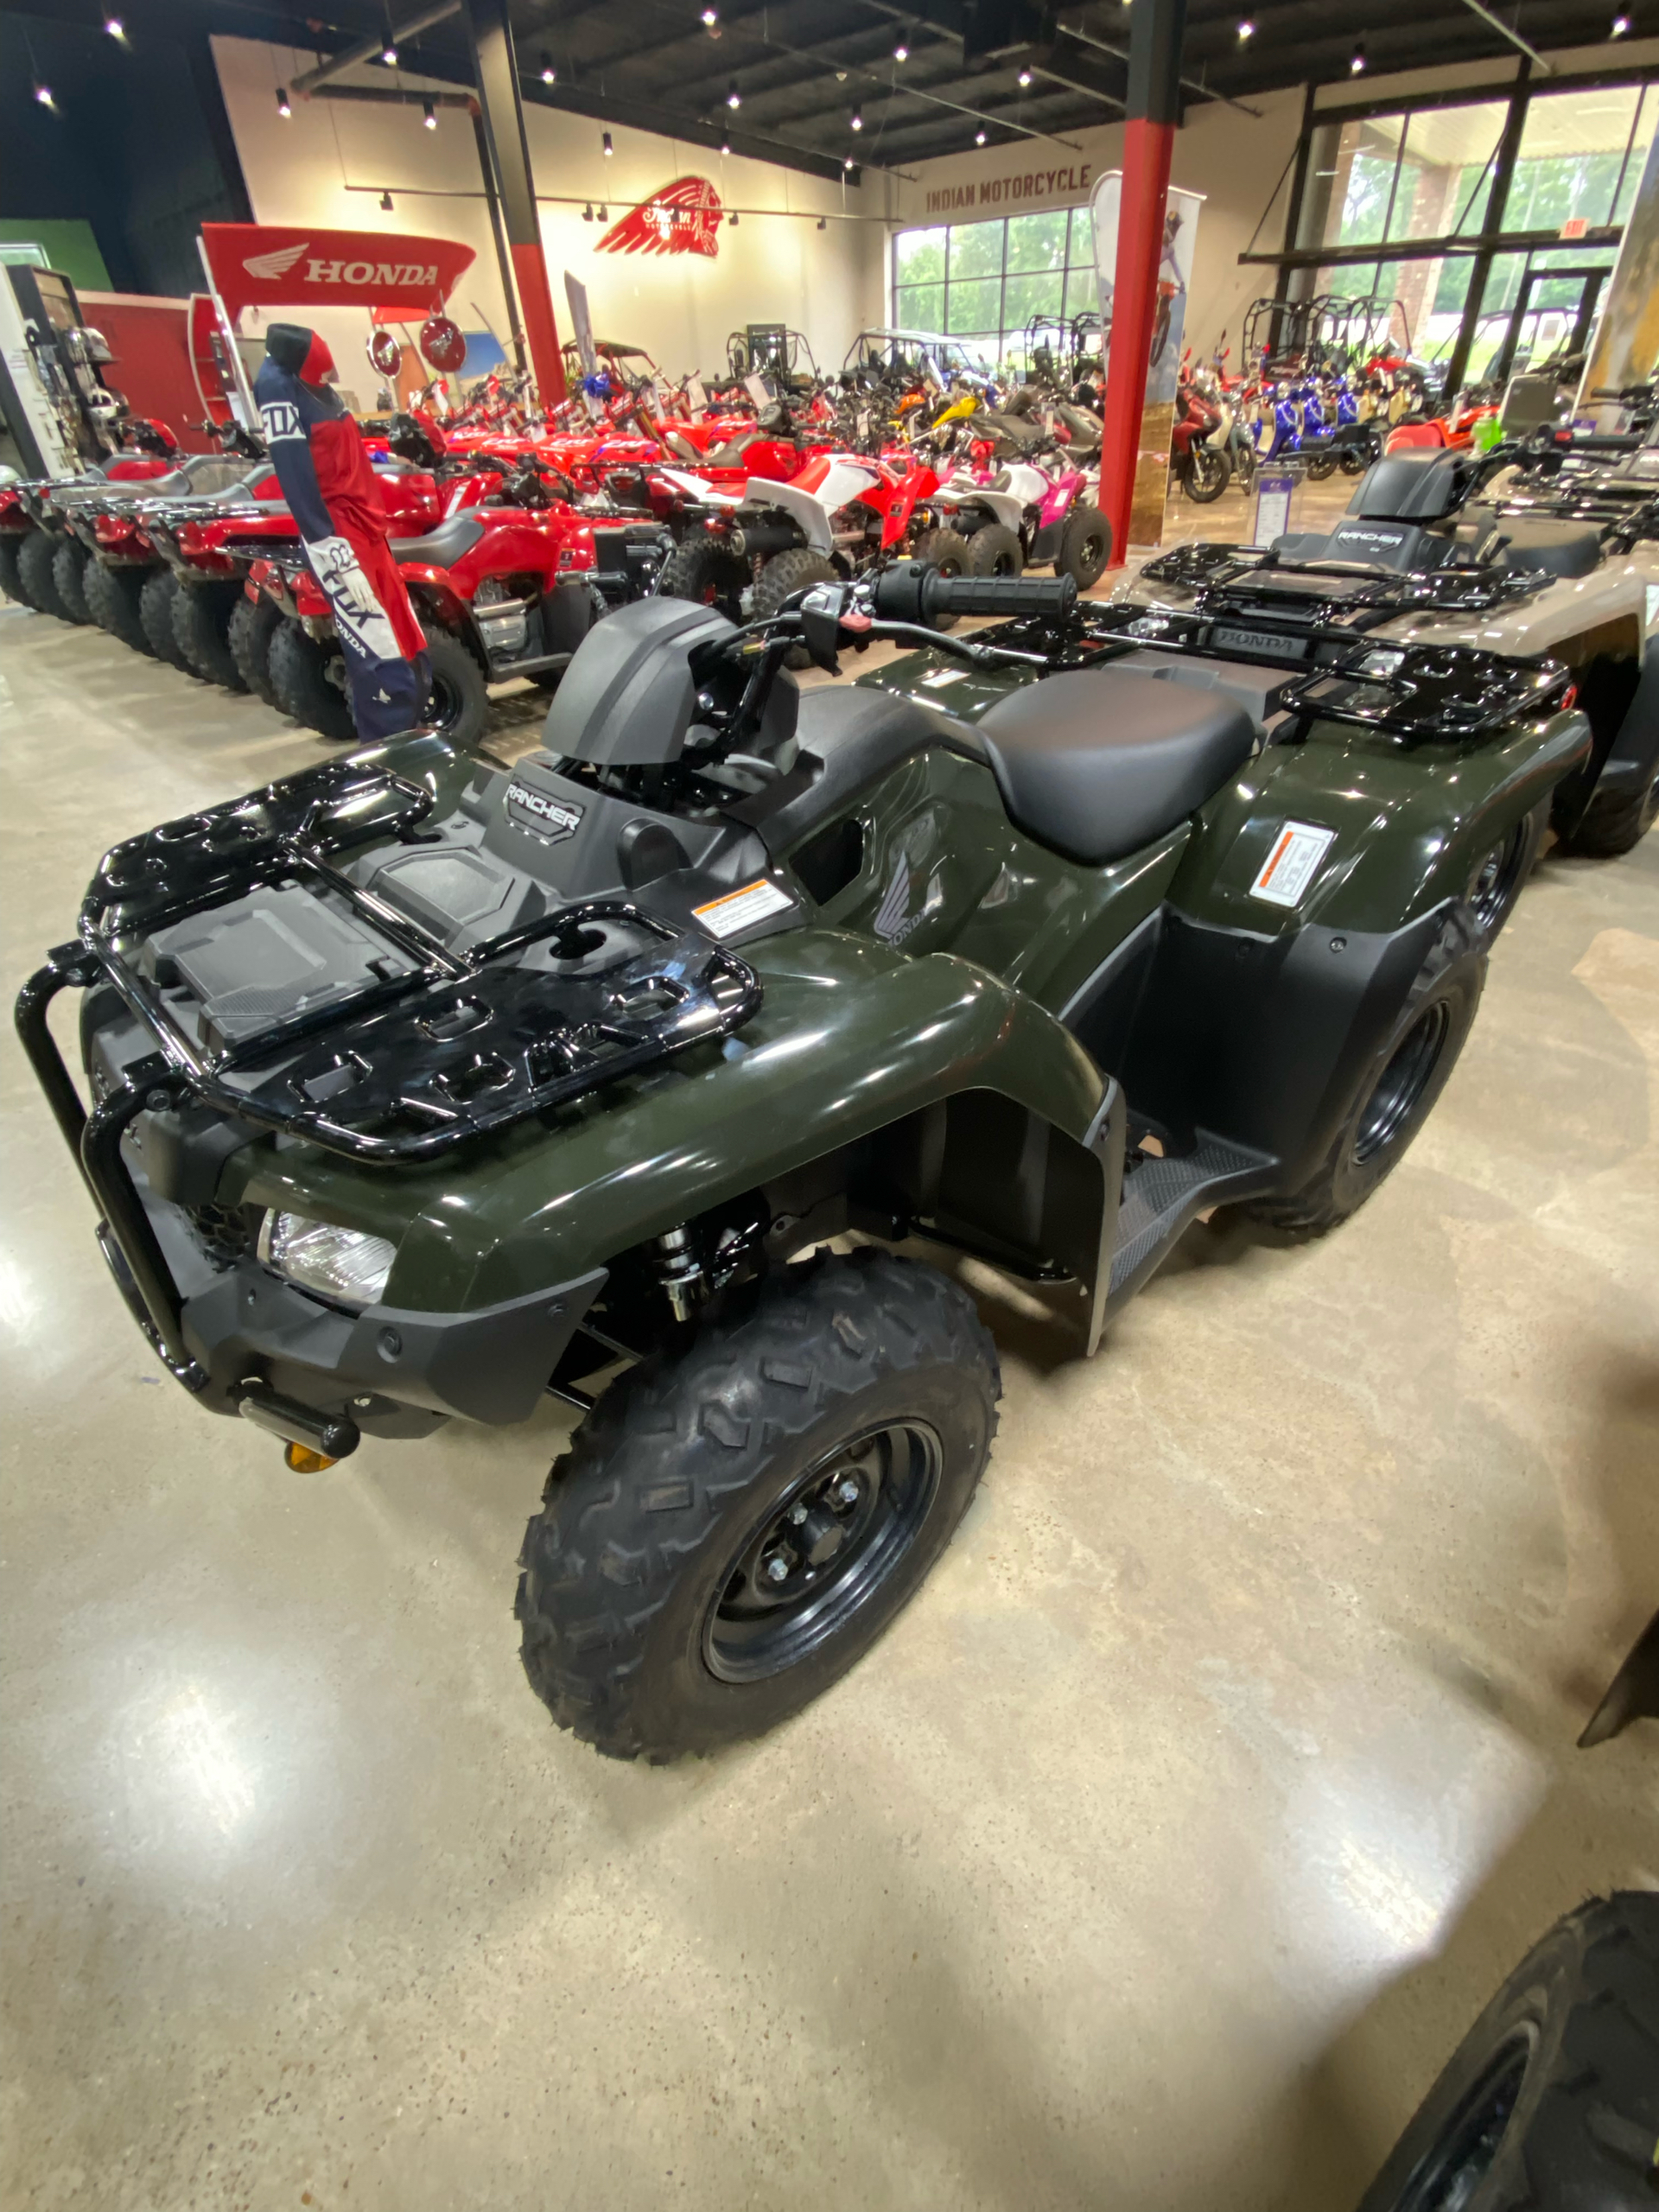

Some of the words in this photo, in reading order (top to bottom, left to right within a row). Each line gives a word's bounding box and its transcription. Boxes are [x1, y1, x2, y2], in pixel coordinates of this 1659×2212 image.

[926, 184, 976, 213] INDIAN
[979, 164, 1092, 204] MOTORCYCLE
[642, 200, 691, 223] Indan
[645, 222, 691, 231] MOTCYCLE
[303, 258, 438, 286] HONDA
[1338, 531, 1403, 545] RANCHER
[335, 615, 366, 658] ONDA
[505, 784, 581, 831] RANCHER
[888, 906, 927, 946] ONDA
